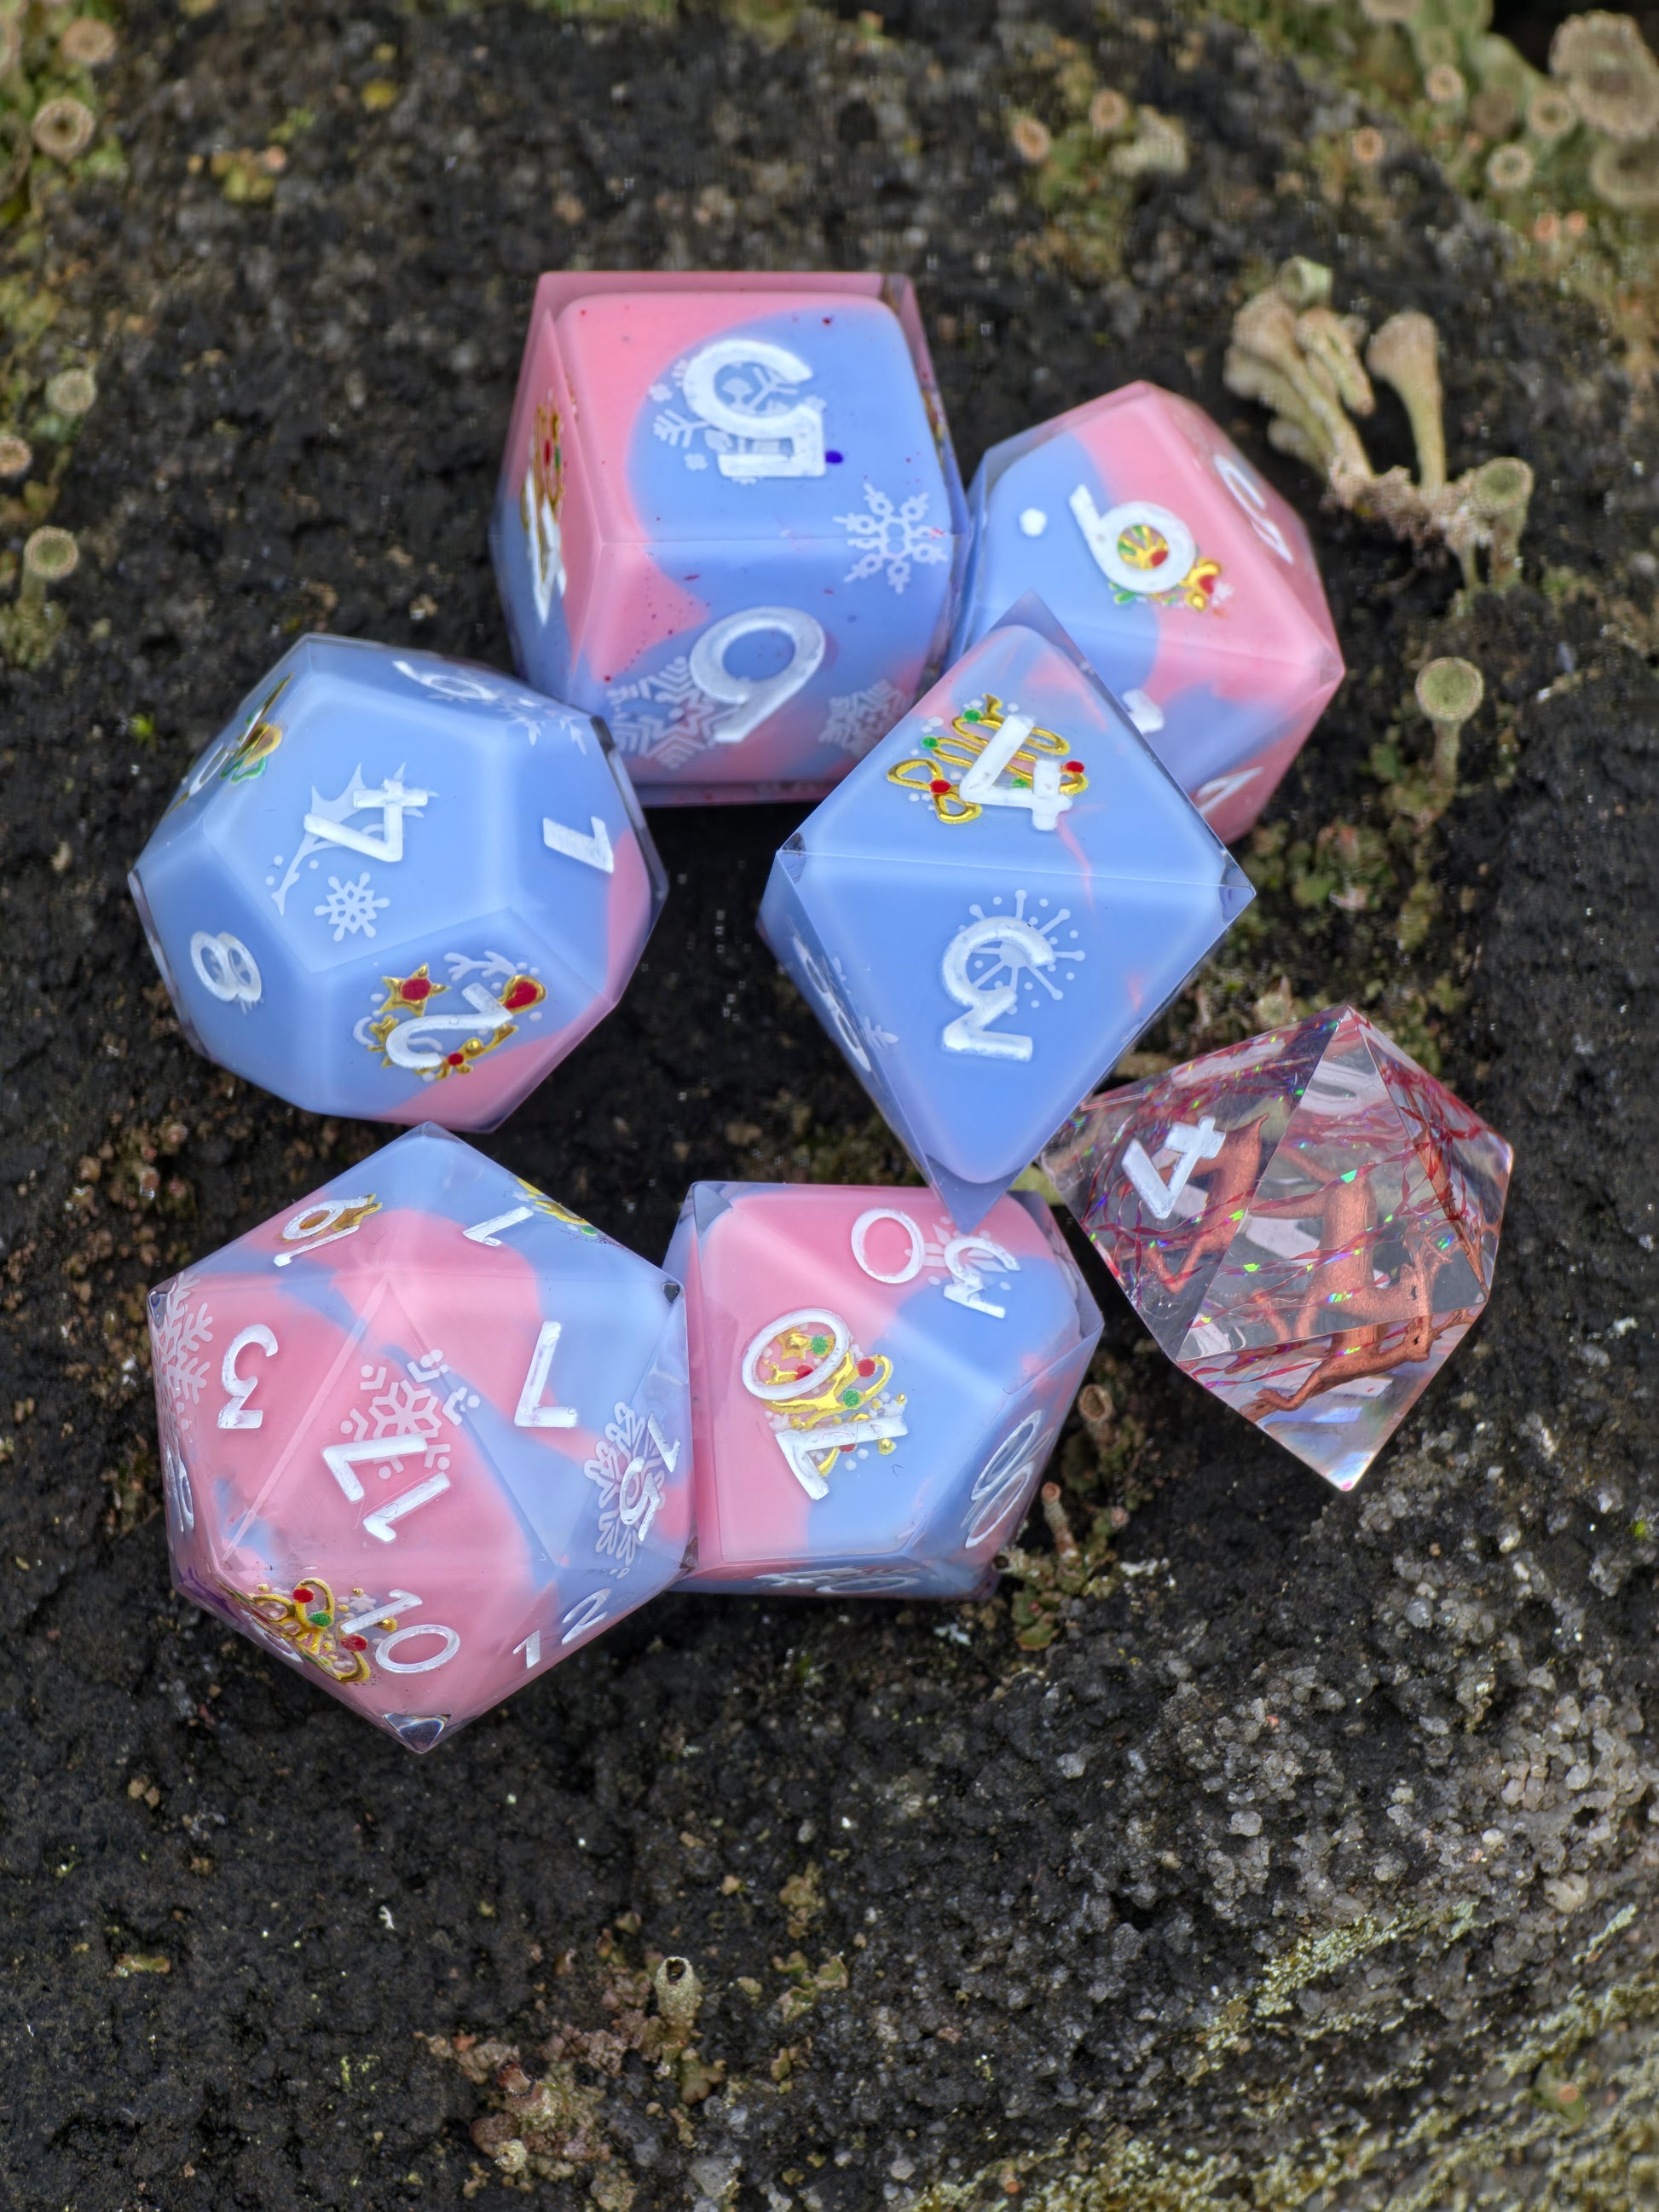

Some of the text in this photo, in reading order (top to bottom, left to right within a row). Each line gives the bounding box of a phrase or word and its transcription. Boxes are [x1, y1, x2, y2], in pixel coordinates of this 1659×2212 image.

[683, 338, 826, 478] 5
[960, 713, 1073, 832] 4
[303, 778, 429, 863] 4
[190, 930, 263, 1002] 8
[385, 982, 514, 1069] 2
[1121, 1116, 1226, 1220] 4
[513, 1320, 578, 1428] 7
[341, 1588, 461, 1674] 10
[512, 1587, 610, 1670] 12
